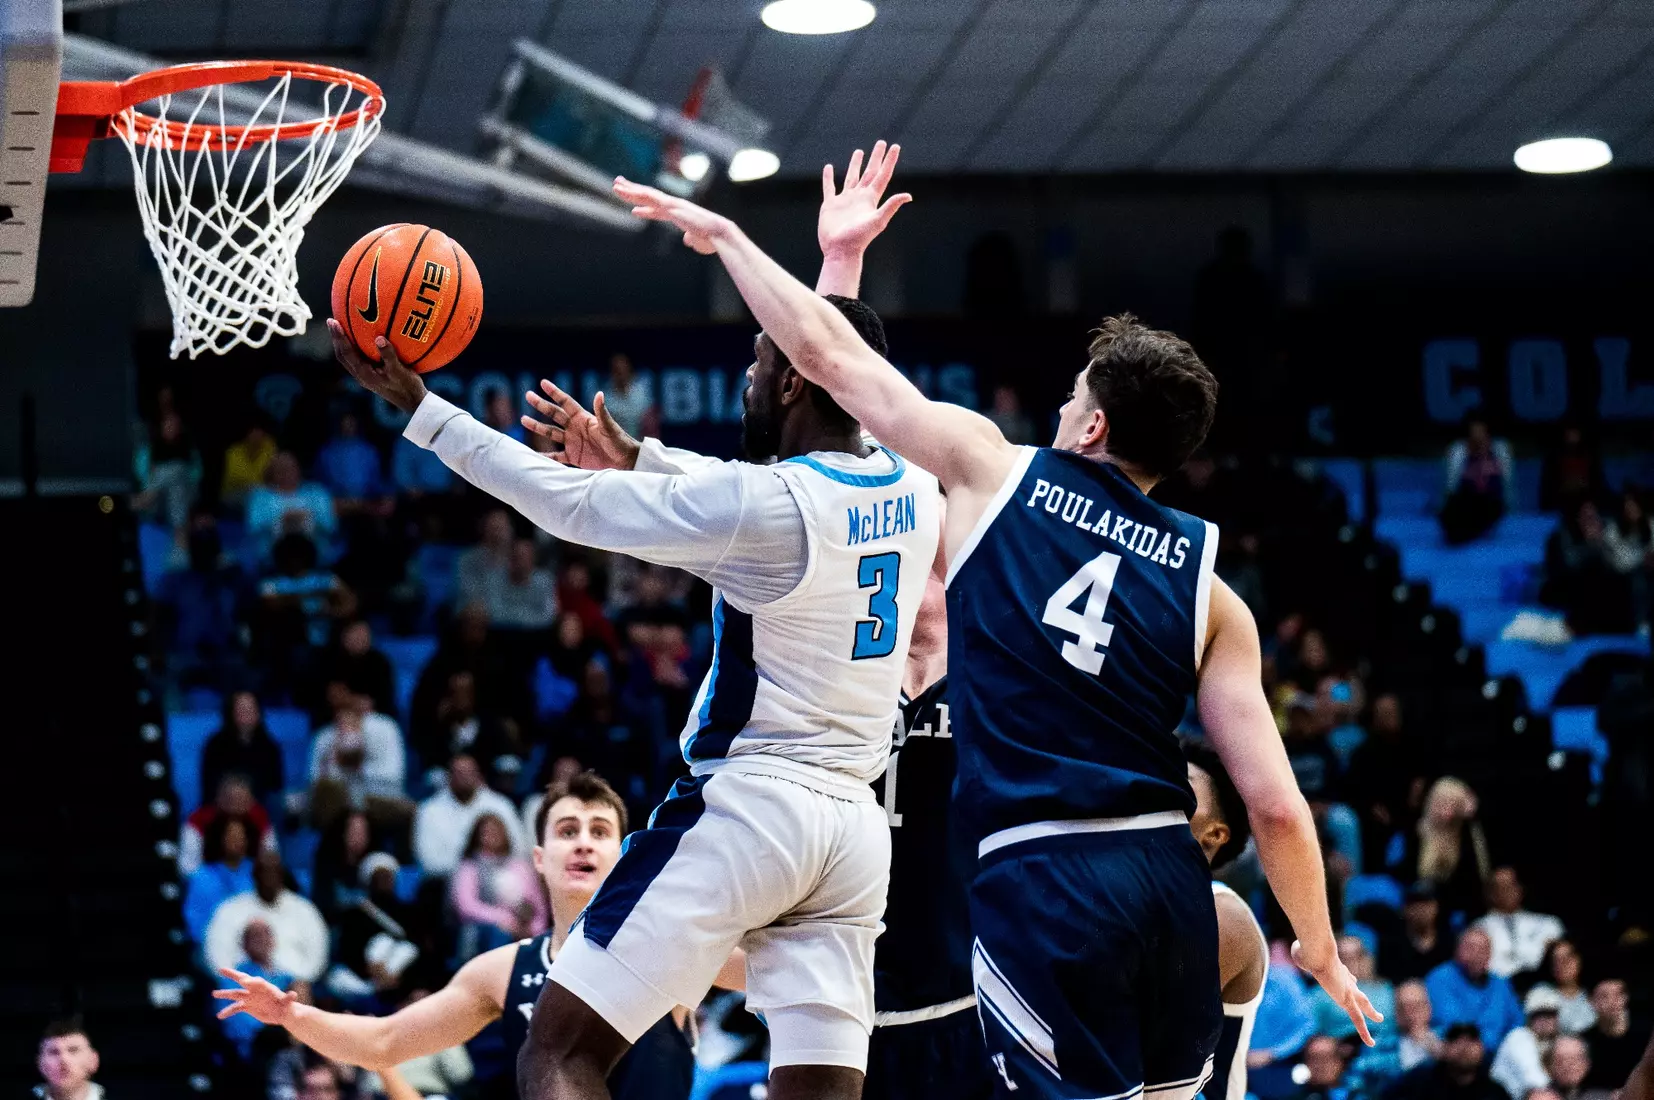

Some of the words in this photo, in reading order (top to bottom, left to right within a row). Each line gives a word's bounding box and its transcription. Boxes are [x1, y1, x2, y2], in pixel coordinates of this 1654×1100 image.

[401, 259, 446, 342] ELITE
[421, 266, 452, 344] CHAMPIOHIP
[847, 492, 916, 546] McLEAN
[1026, 478, 1191, 570] POULAKIDAS
[851, 551, 901, 661] 3
[1041, 551, 1122, 676] 4
